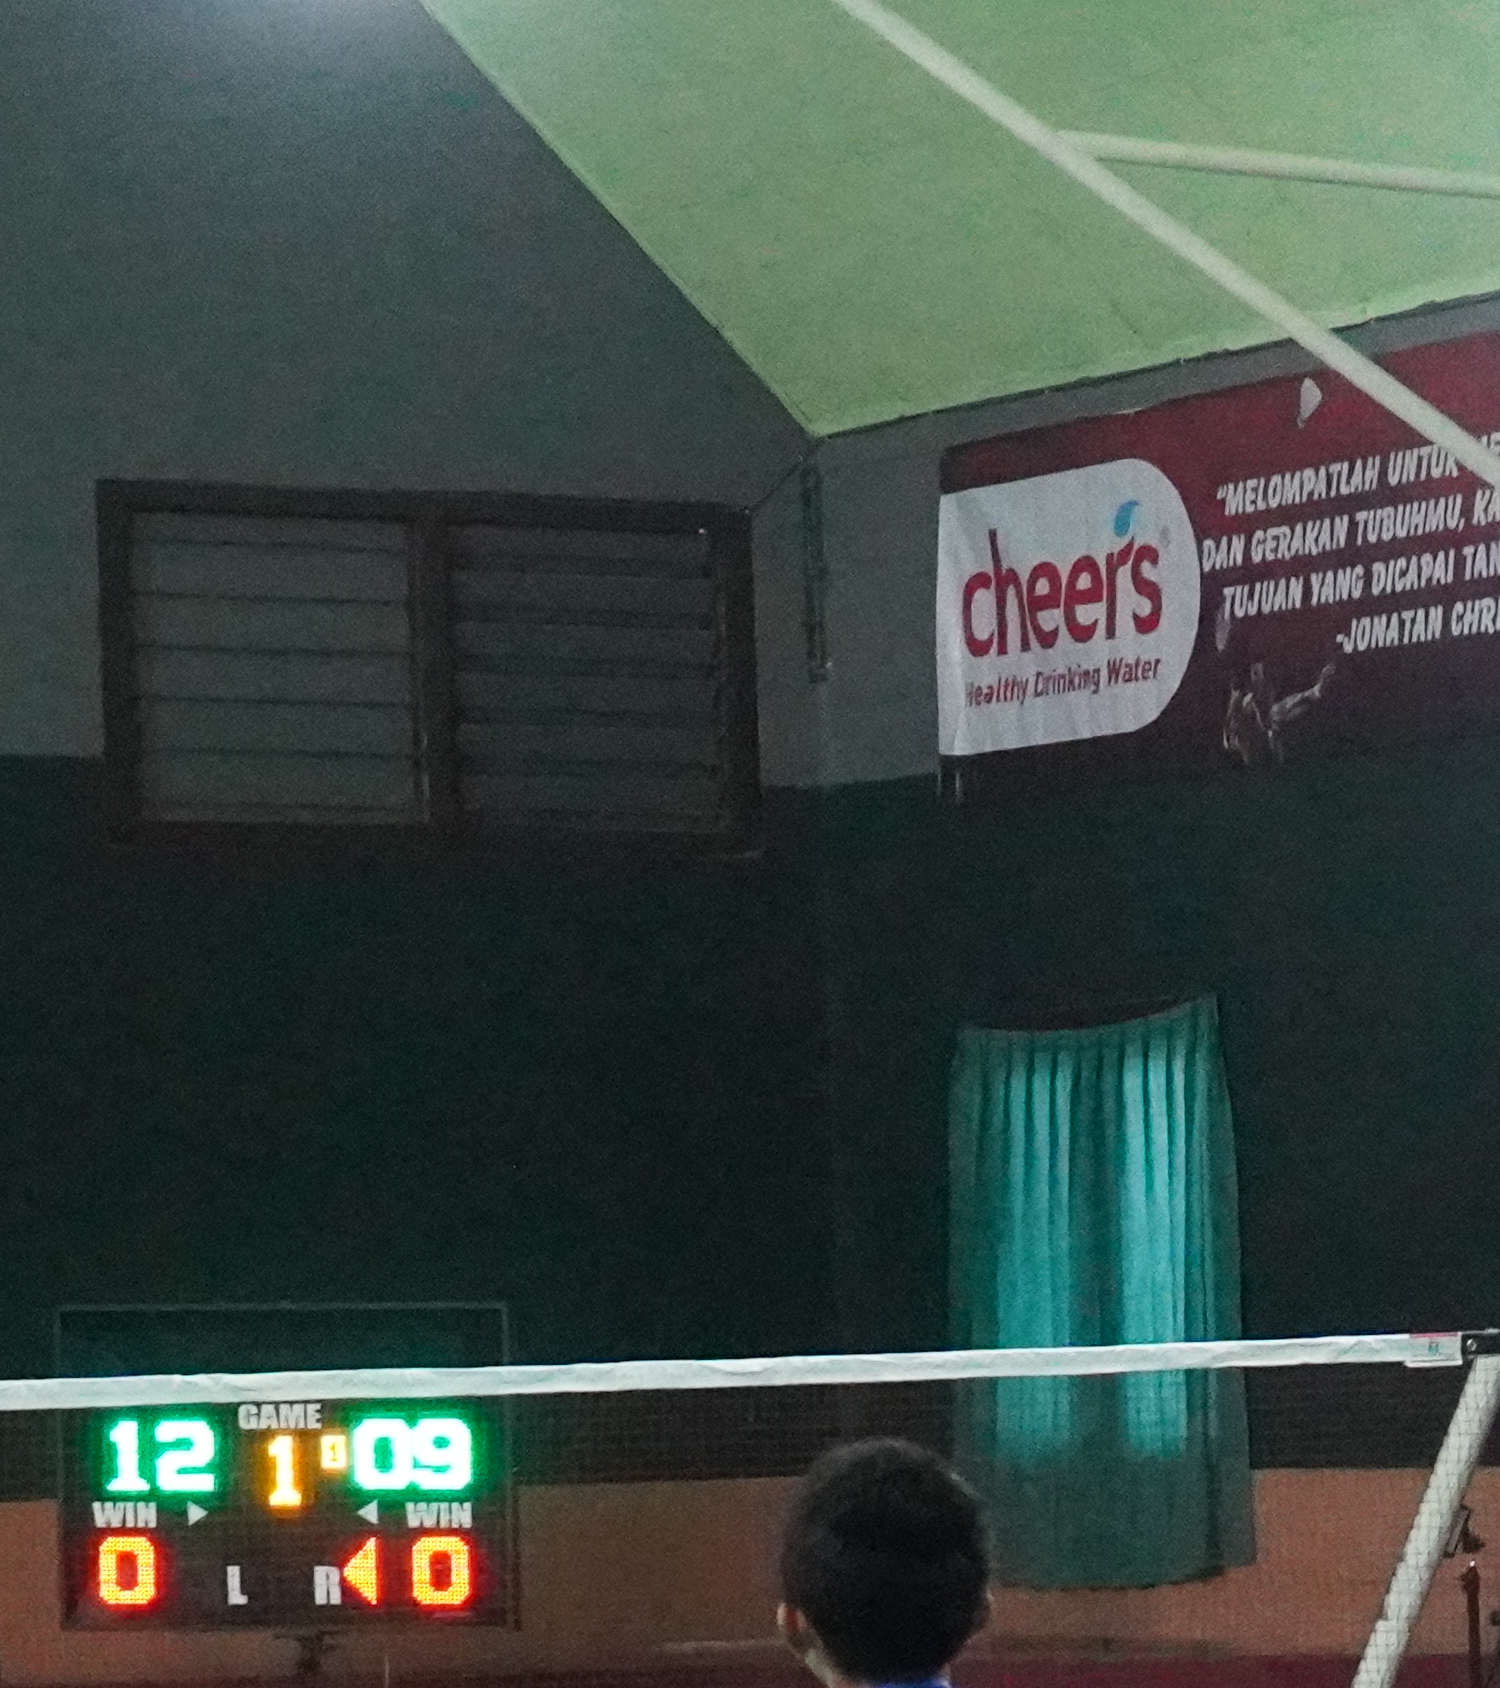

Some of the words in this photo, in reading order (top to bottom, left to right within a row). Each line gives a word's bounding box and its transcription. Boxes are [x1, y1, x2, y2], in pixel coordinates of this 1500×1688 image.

[1202, 533, 1245, 572] DAN
[1251, 515, 1348, 564] GERAKAN
[1356, 494, 1465, 545] TUBUHMU,
[1223, 576, 1303, 620] TUJUAN
[1311, 564, 1364, 606] YANG
[1371, 549, 1455, 597] DICAPAI
[1034, 664, 1101, 697] Drinking
[1106, 657, 1161, 685] Water
[238, 1403, 322, 1430] GAME
[106, 1419, 216, 1492] 12
[267, 1435, 302, 1507] 1
[353, 1417, 472, 1491] 09
[92, 1502, 157, 1528] WIN
[405, 1502, 473, 1529] WIN
[99, 1536, 156, 1605] 0
[226, 1566, 249, 1605] L
[412, 1536, 471, 1605] 0
